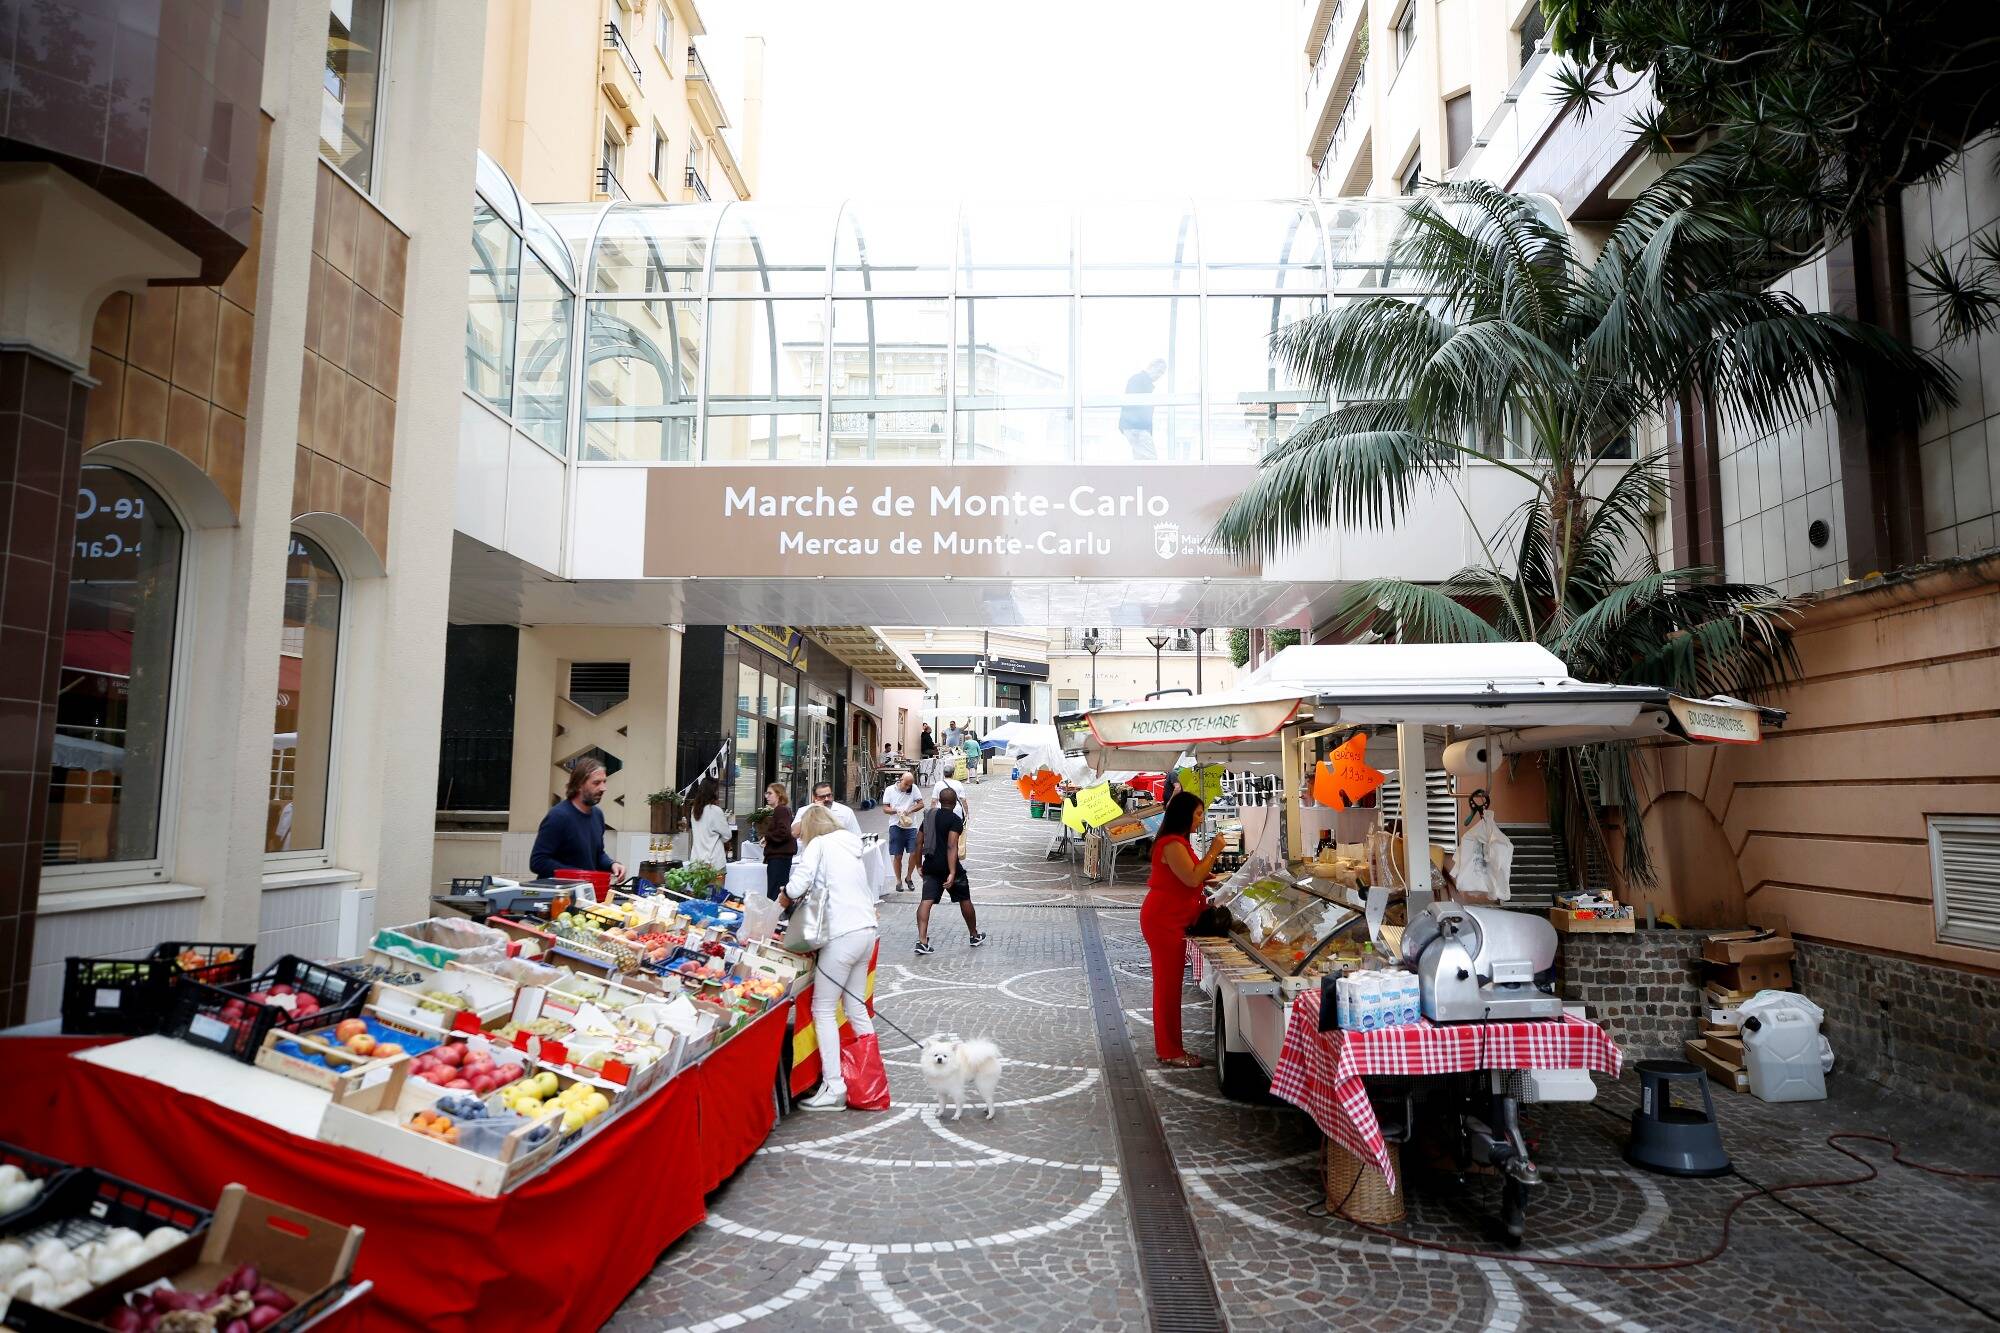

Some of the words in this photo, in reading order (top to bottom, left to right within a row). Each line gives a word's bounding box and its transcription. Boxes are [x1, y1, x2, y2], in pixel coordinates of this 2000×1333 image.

[724, 486, 858, 517] Marché
[872, 486, 915, 517] de
[930, 486, 1170, 518] Monte-Carlo
[779, 532, 879, 556] Mercau
[889, 532, 927, 556] de
[935, 532, 1112, 556] Munte-Carlu
[1181, 546, 1194, 555] de
[1131, 714, 1241, 734] MOUSTIERS-STE-MARIE
